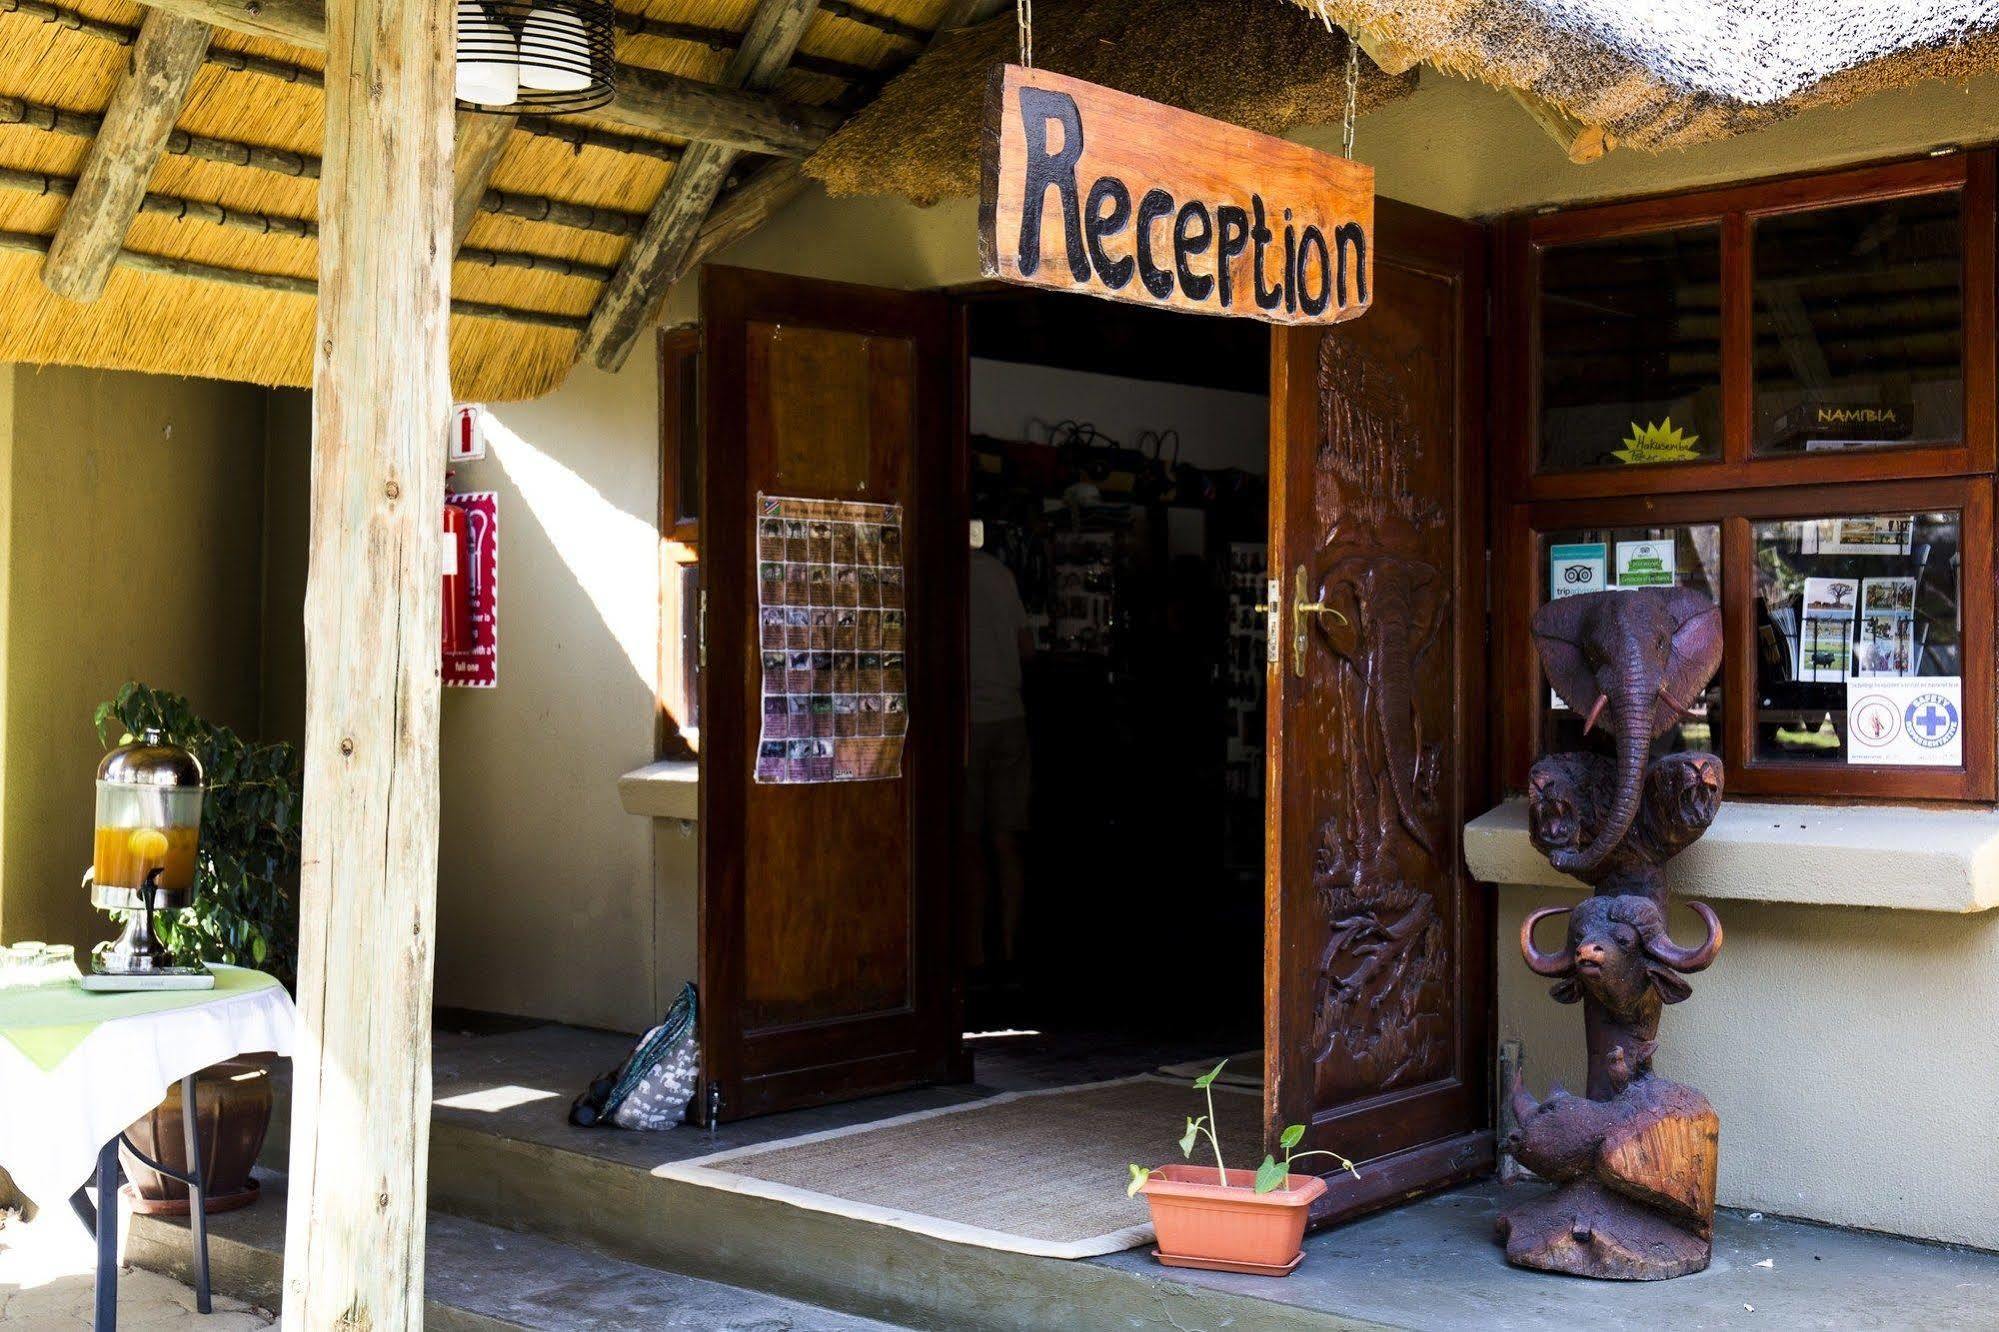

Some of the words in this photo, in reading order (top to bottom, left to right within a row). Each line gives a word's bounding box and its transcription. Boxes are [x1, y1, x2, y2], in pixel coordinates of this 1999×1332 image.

[1018, 86, 1368, 317] Reception
[1817, 408, 1896, 422] NAMIBIA
[455, 661, 466, 672] full
[467, 663, 479, 672] one
